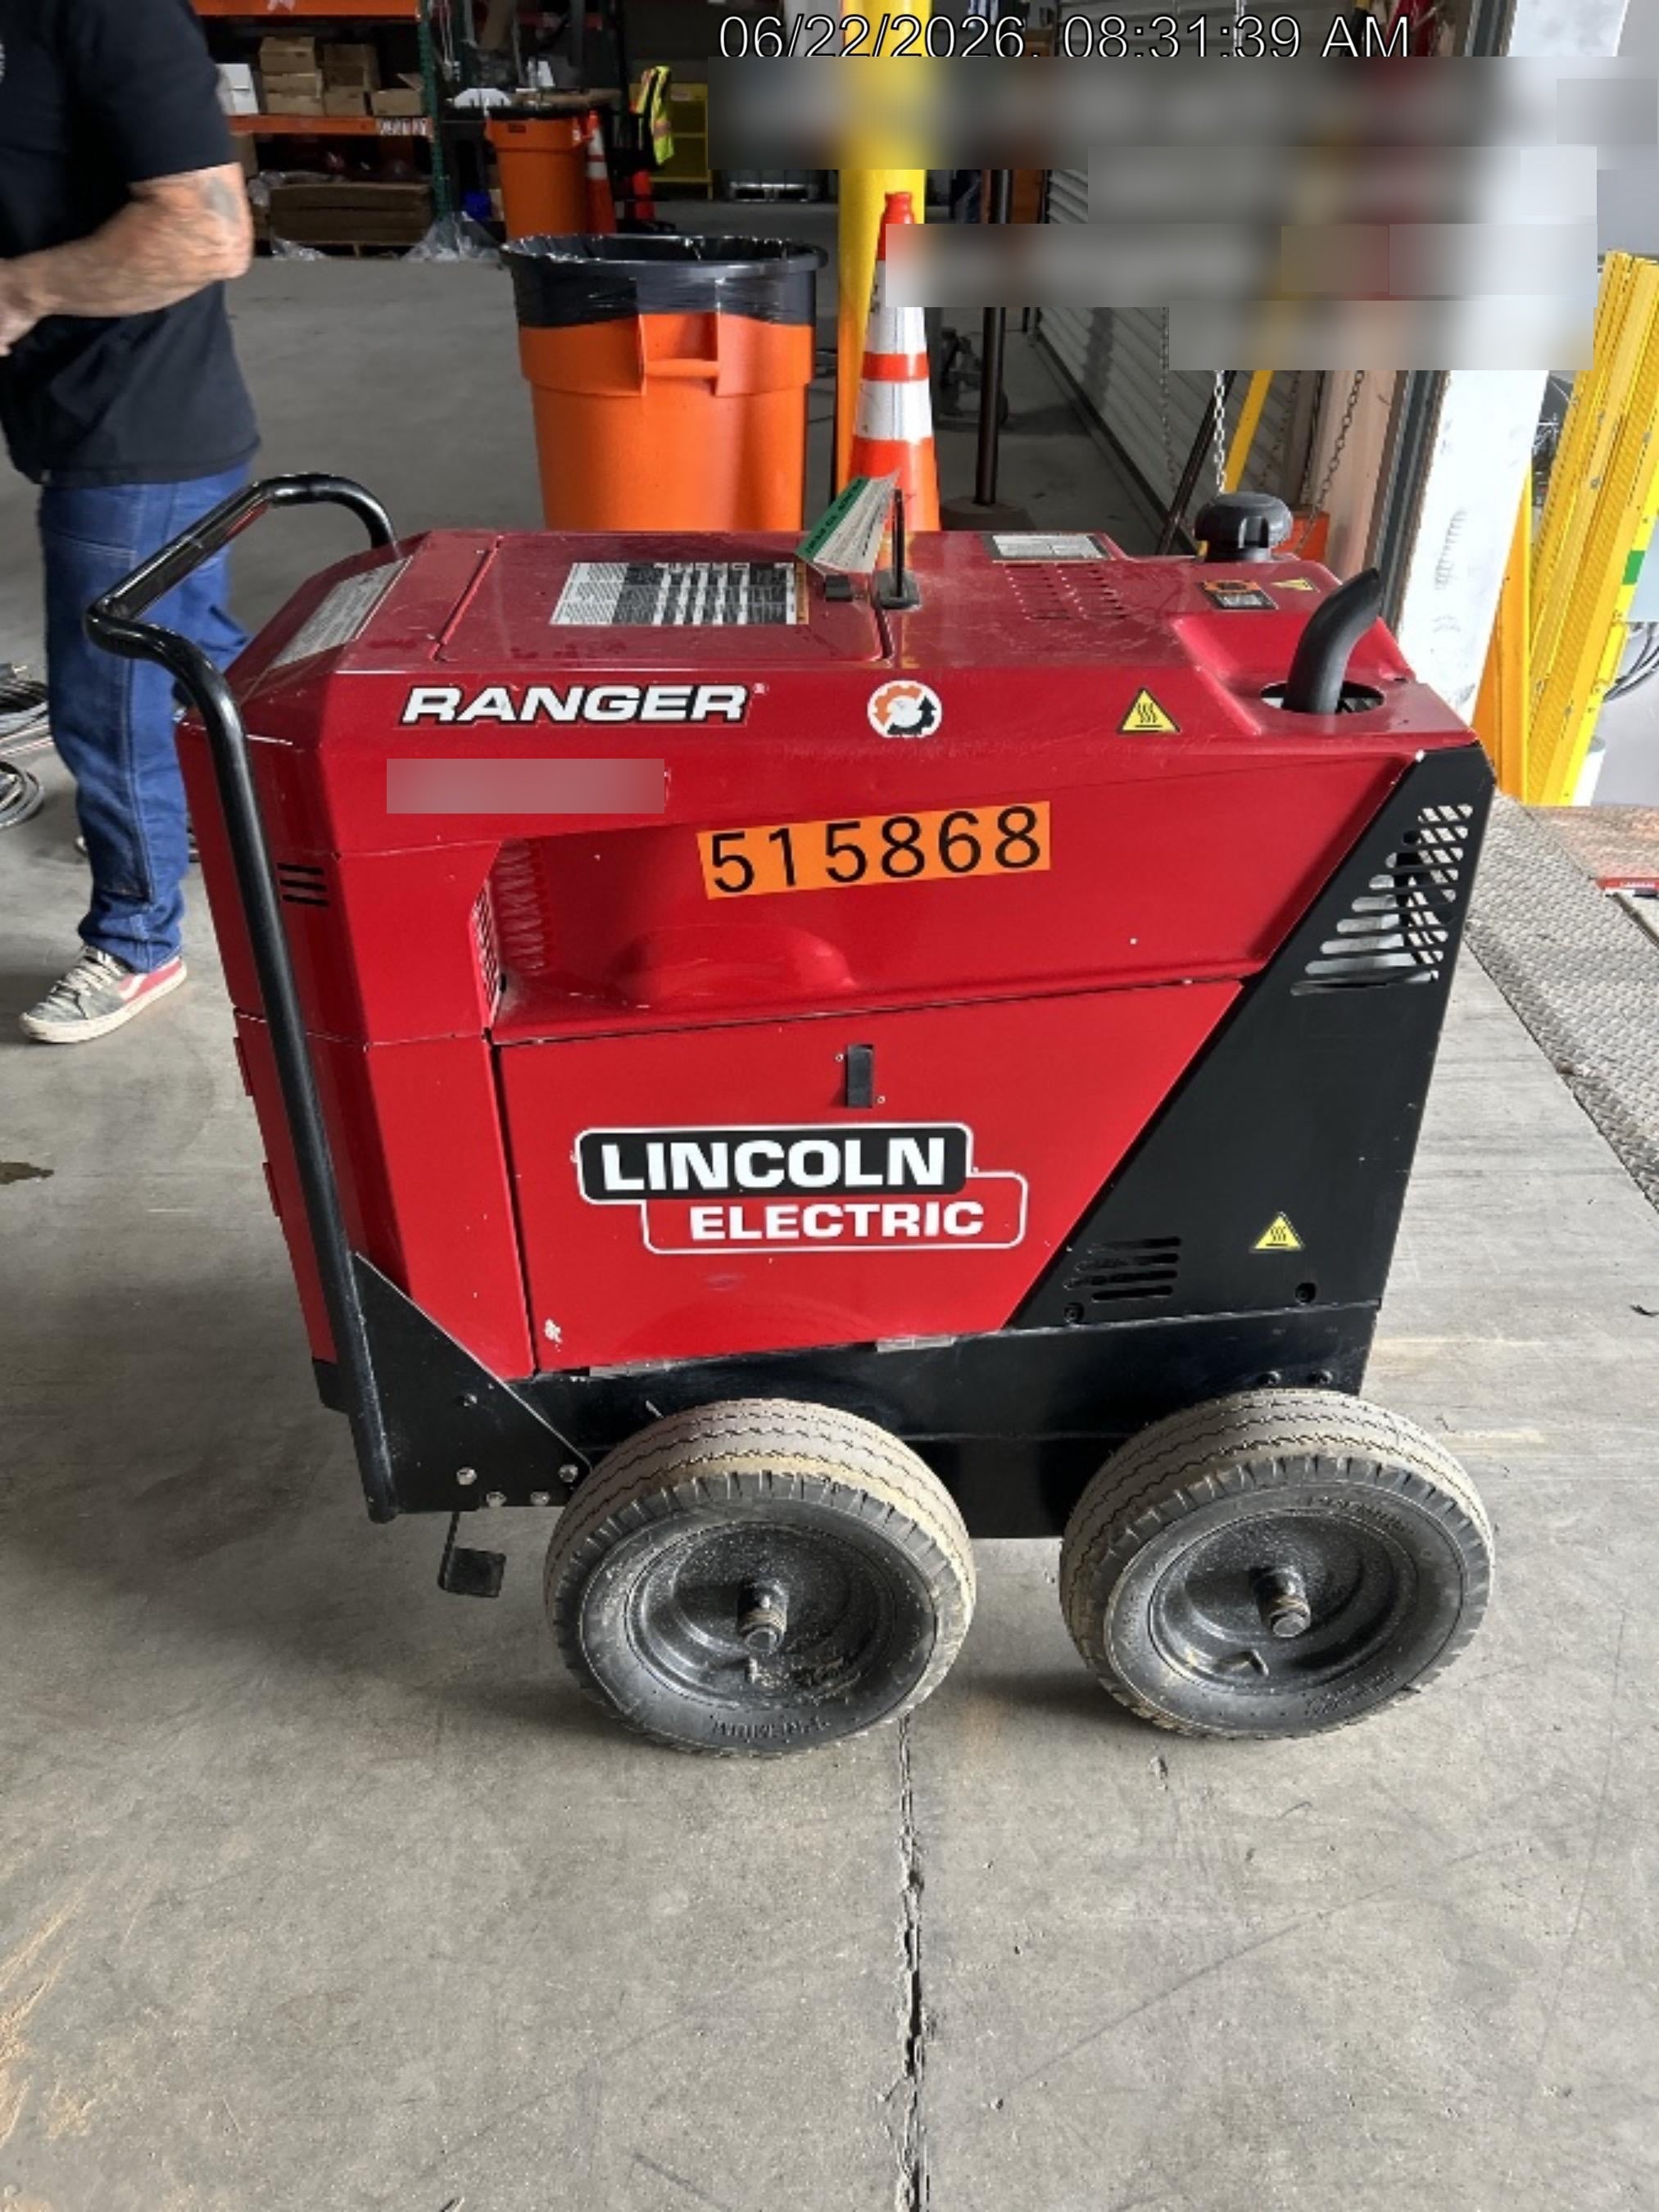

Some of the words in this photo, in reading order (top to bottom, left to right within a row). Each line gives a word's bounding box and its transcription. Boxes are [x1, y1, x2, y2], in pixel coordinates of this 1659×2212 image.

[712, 805, 1040, 893] 515868
[601, 1137, 945, 1191] LINCOLN
[690, 1200, 984, 1240] ELECTRIC
